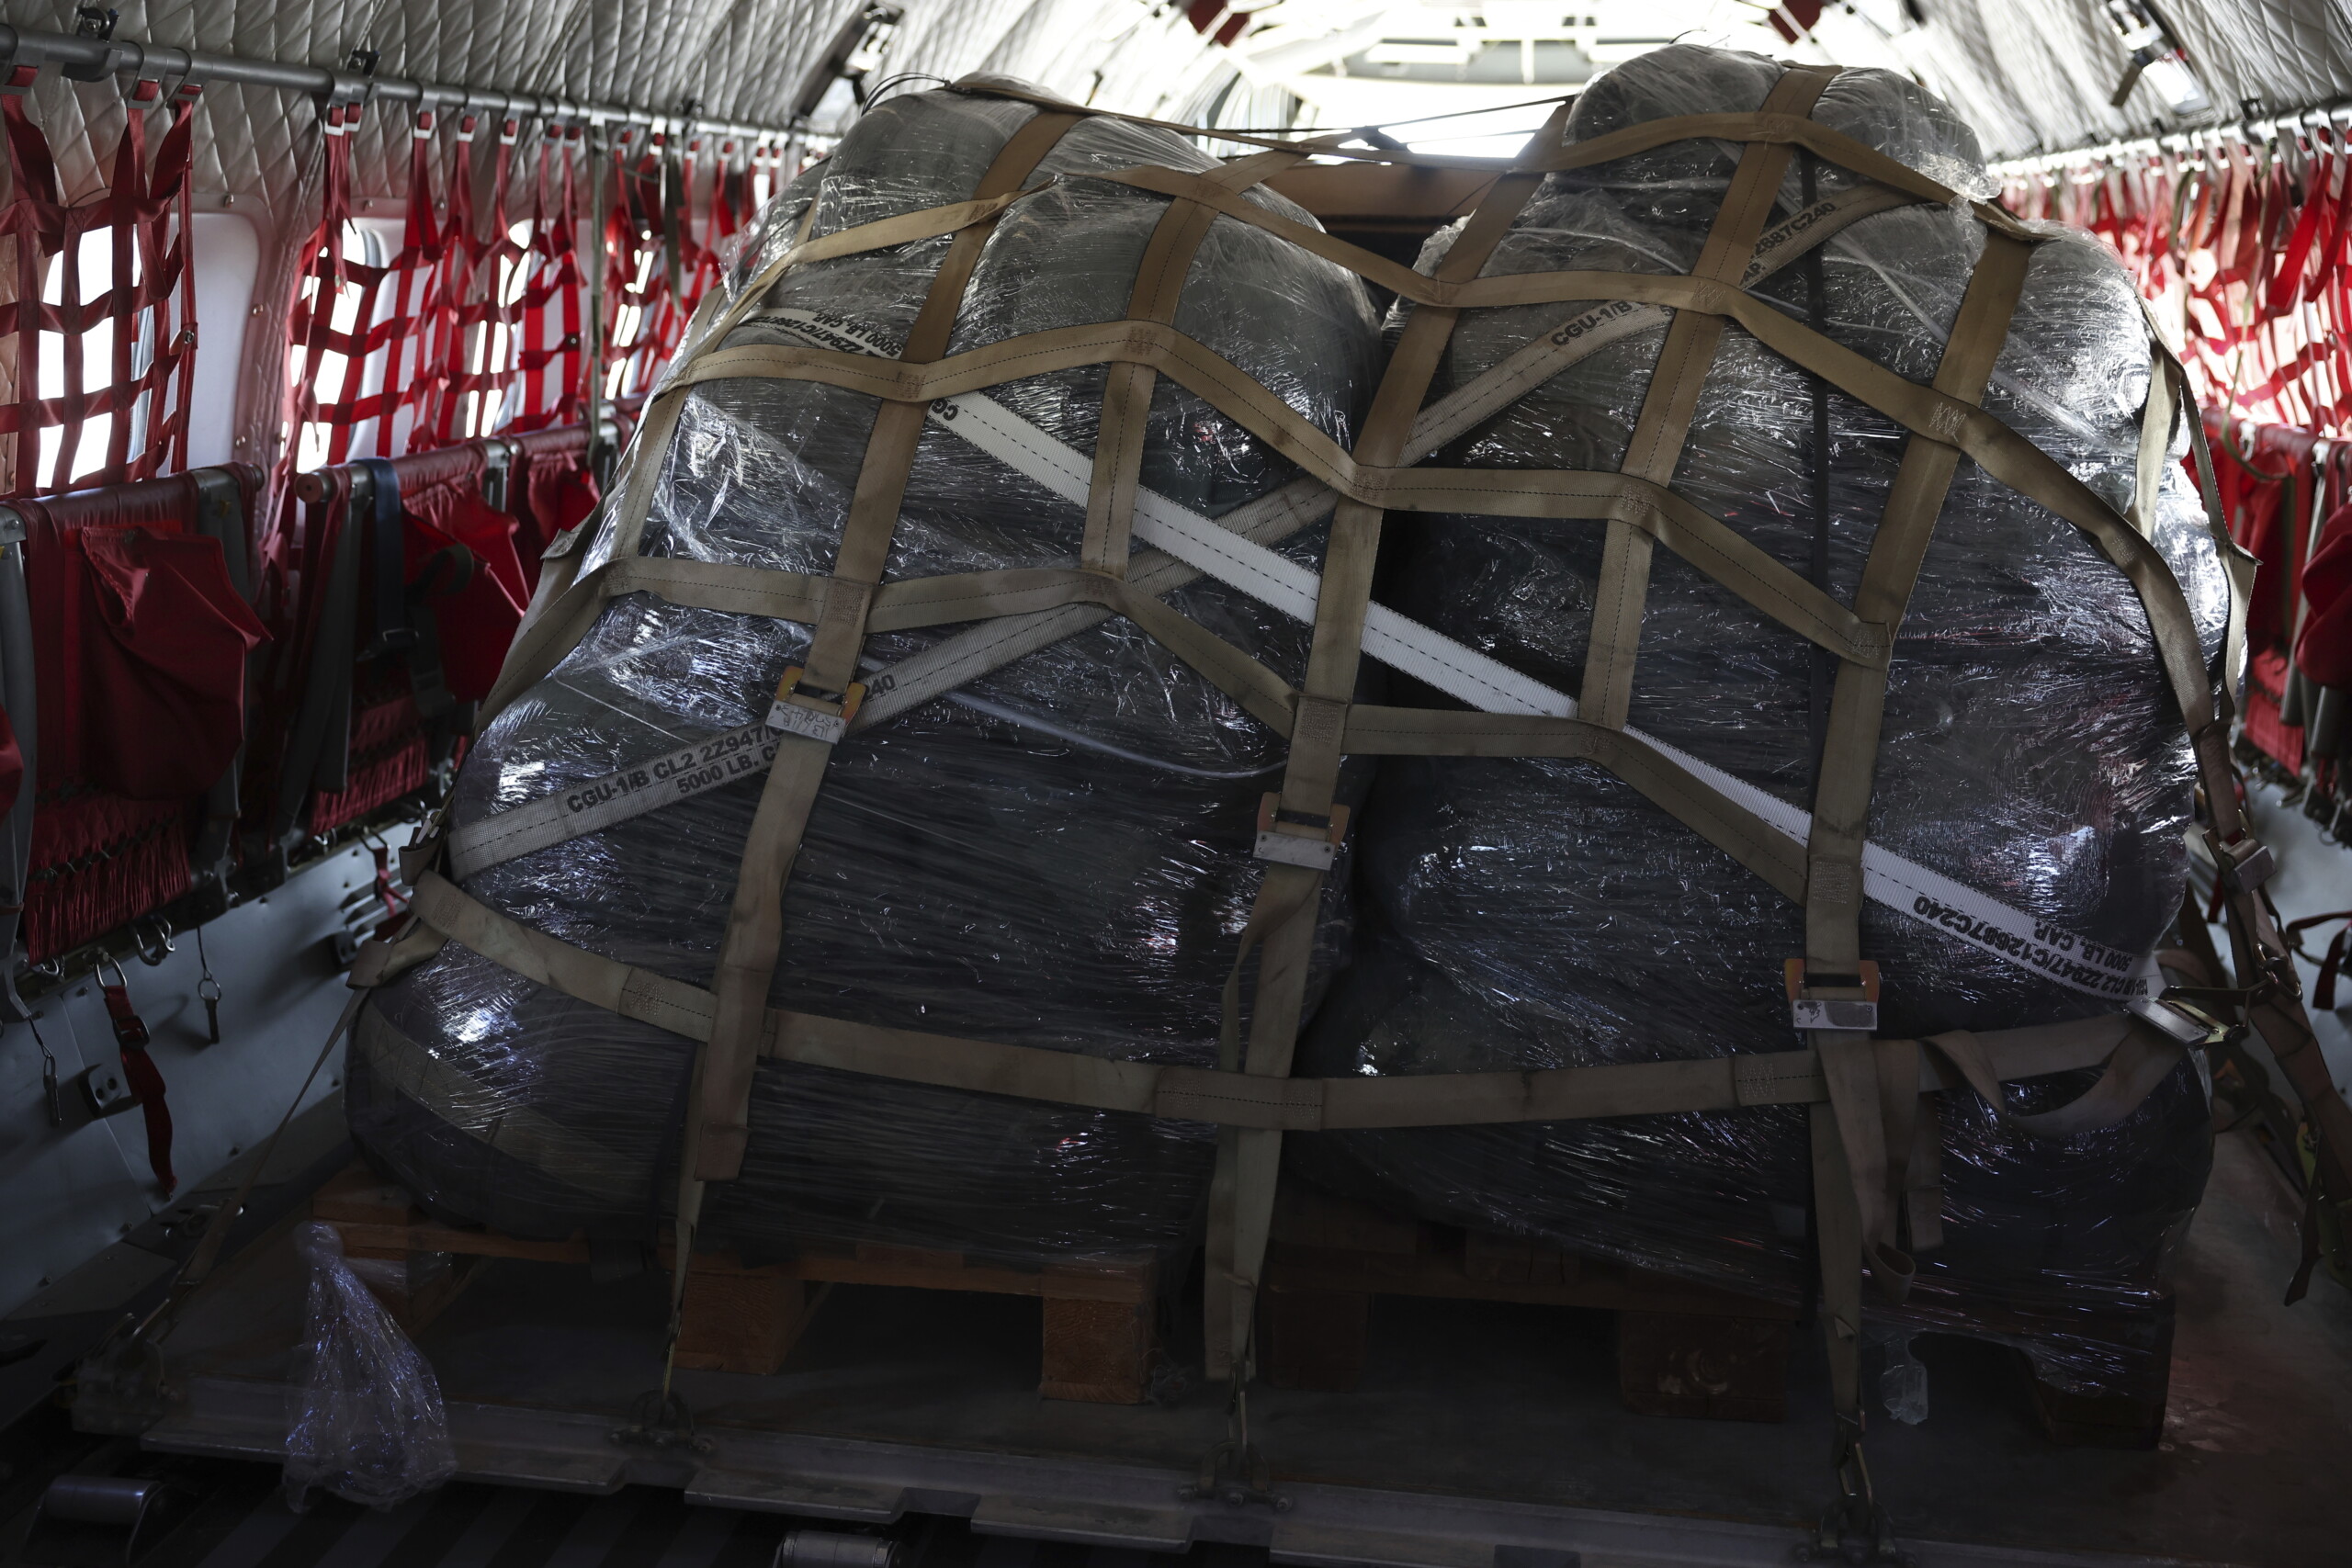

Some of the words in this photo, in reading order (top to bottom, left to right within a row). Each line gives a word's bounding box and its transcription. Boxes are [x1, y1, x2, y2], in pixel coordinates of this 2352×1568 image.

[1750, 202, 1837, 259] 2687C240
[1551, 300, 1633, 346] CGU-1/B
[653, 752, 697, 779] CL2
[676, 764, 724, 794] 5000
[726, 754, 759, 775] LB.
[2033, 920, 2075, 952] CAP.
[2079, 939, 2106, 964] LB.
[2104, 952, 2133, 973] 5000
